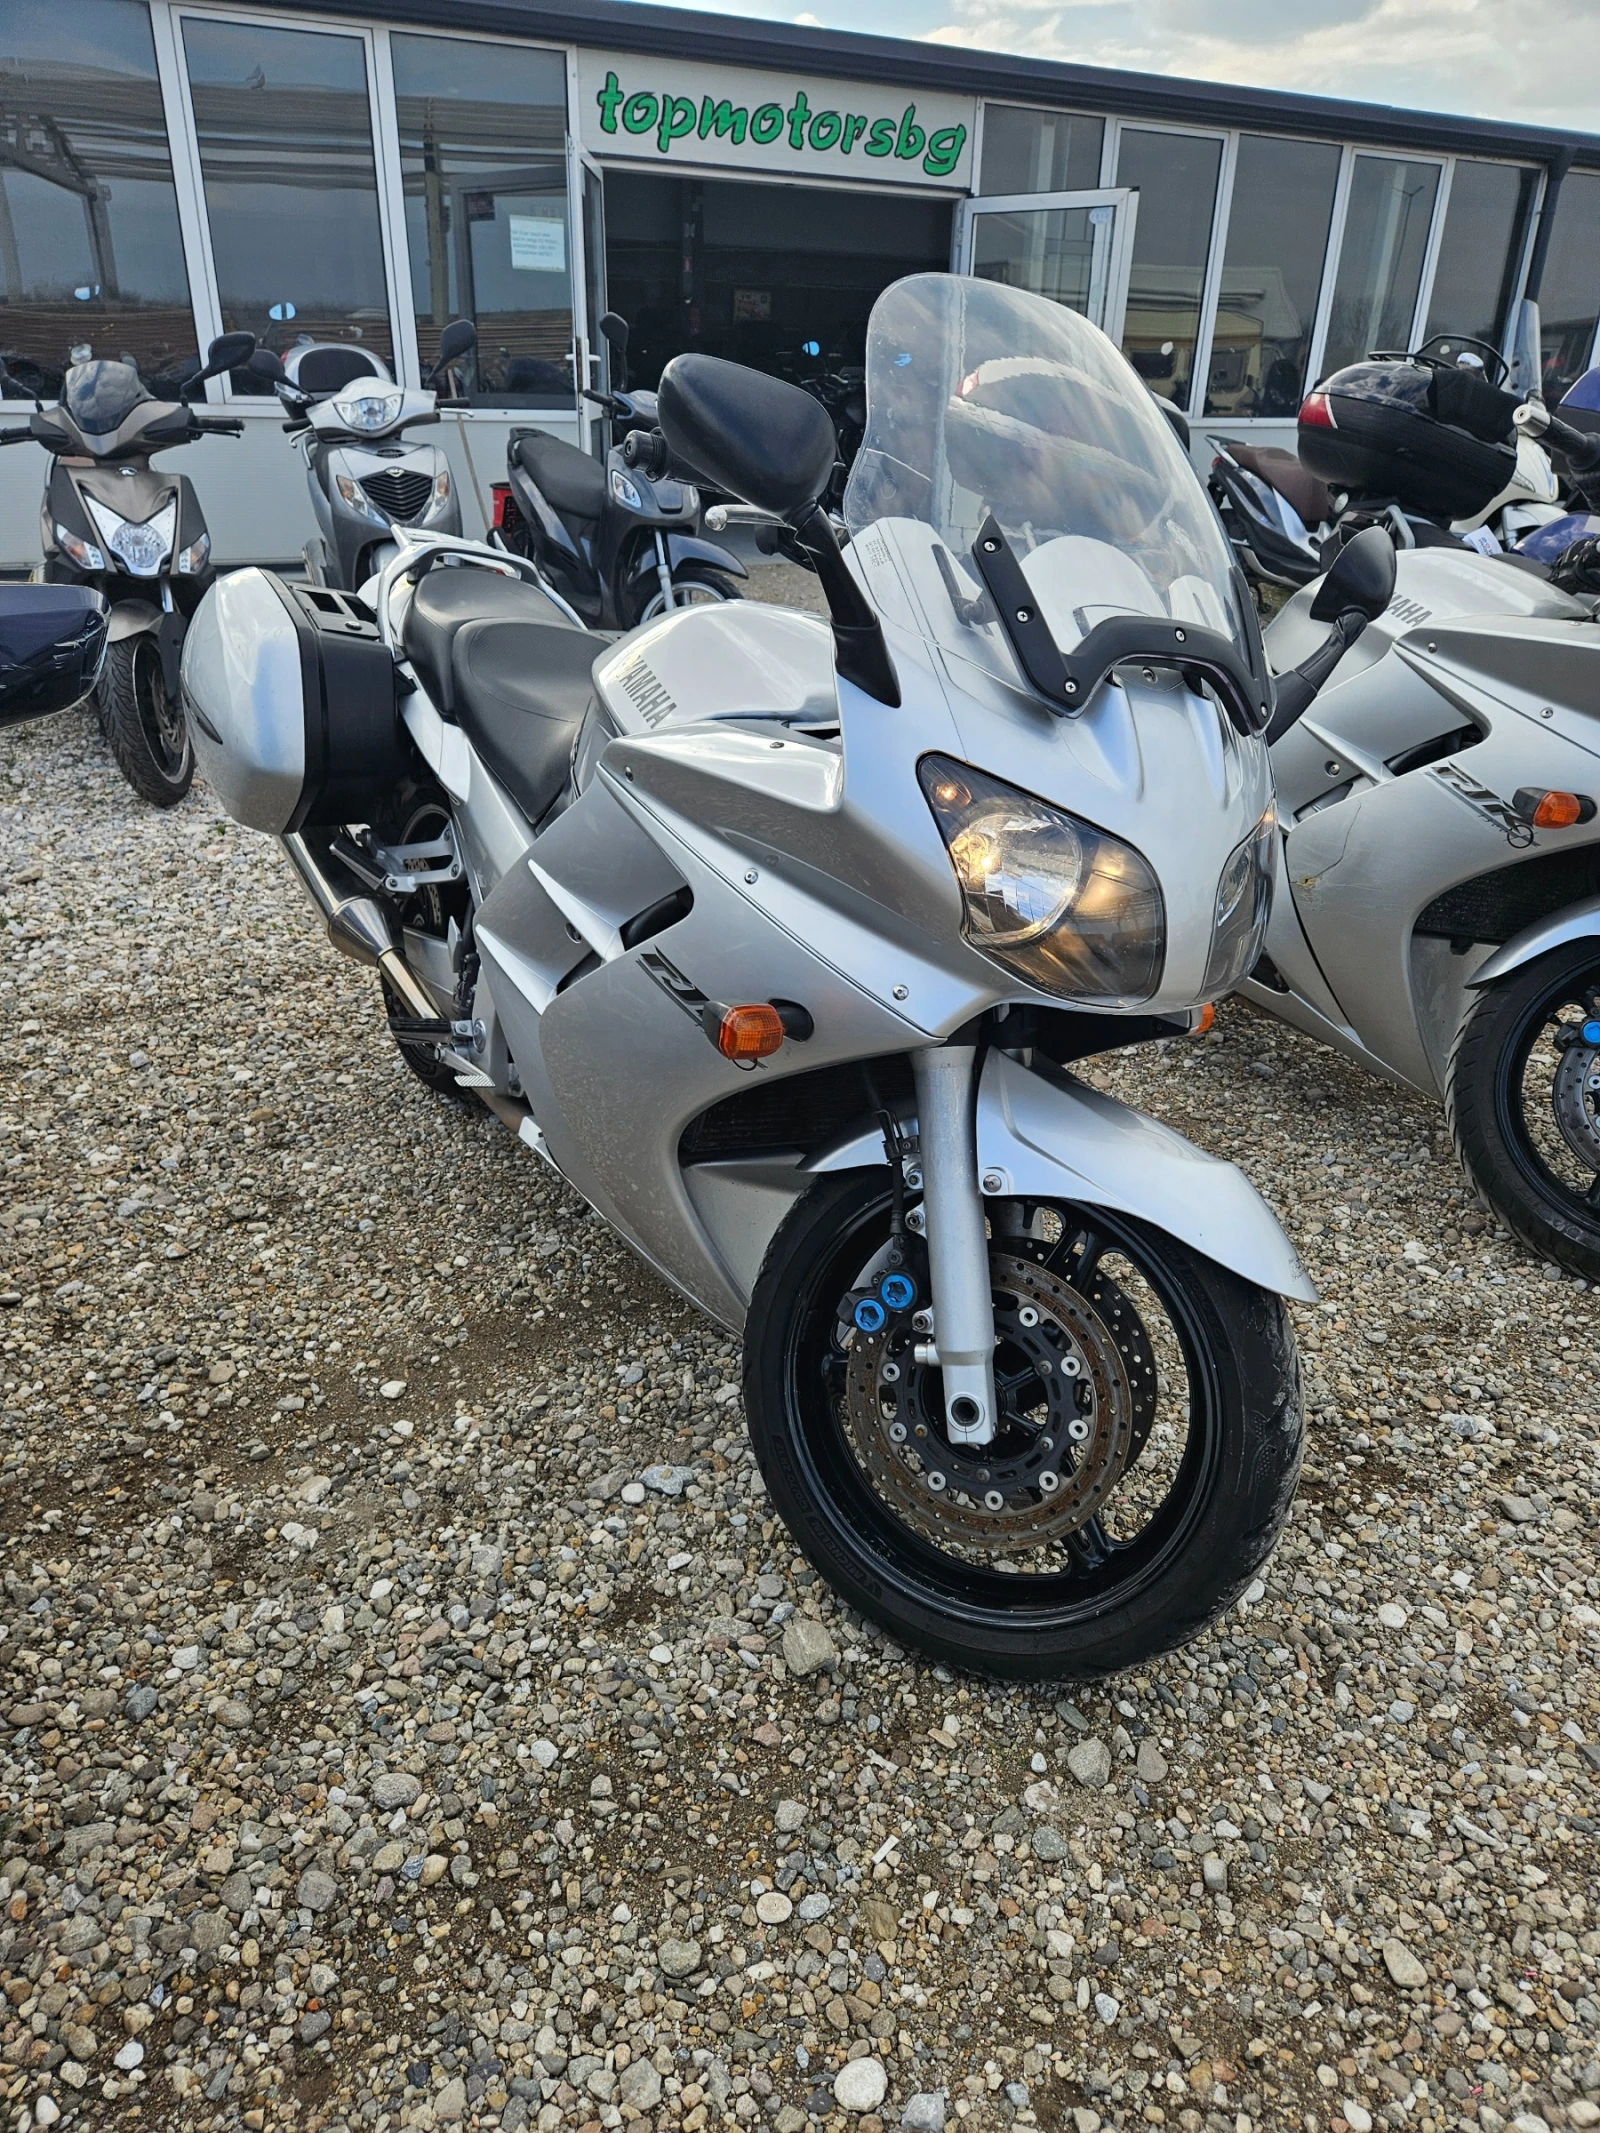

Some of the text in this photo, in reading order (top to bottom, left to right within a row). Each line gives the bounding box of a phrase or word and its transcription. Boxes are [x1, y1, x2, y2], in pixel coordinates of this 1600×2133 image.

[597, 71, 967, 177] topmotorsbg
[1386, 592, 1433, 628] AHA
[615, 654, 678, 730] YAMAHA
[811, 1520, 866, 1584] MICHELIN
